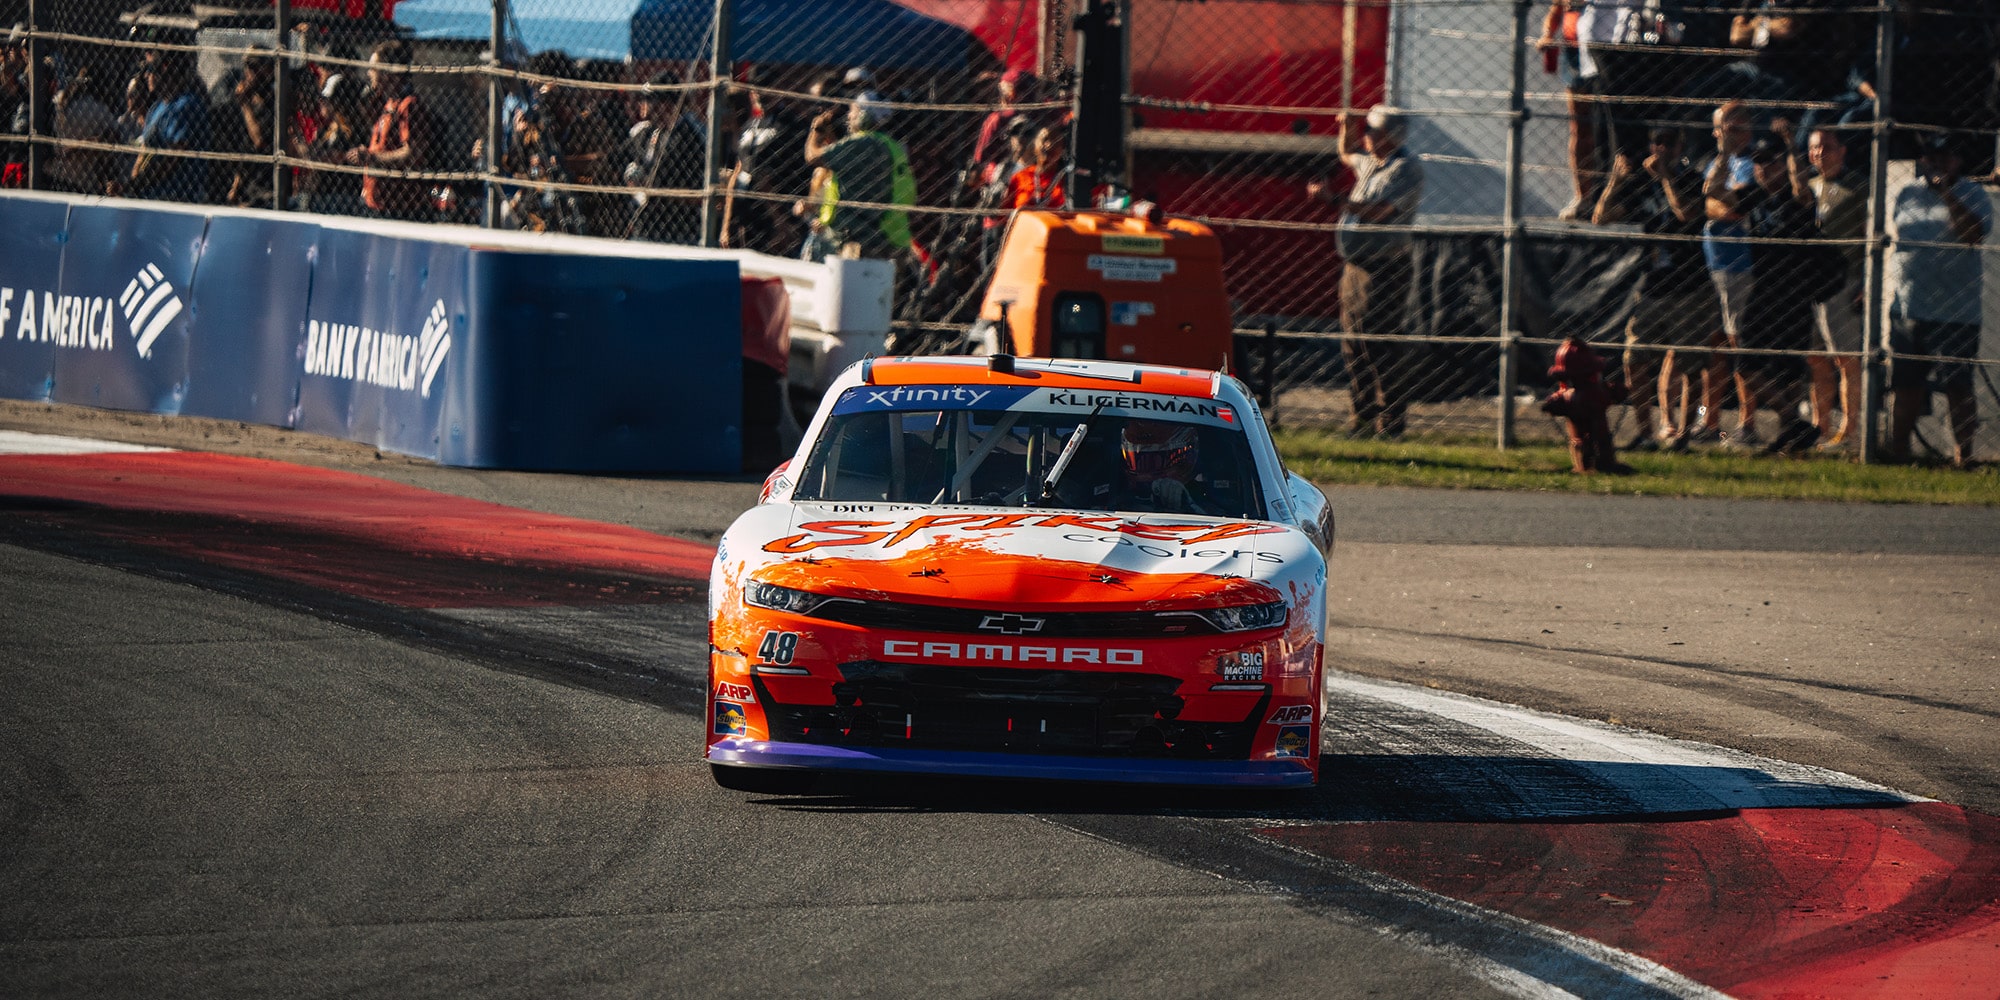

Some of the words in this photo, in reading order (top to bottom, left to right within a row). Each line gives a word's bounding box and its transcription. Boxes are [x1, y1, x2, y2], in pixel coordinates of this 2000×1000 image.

[0, 287, 14, 340] F
[304, 319, 360, 380] BANK
[367, 330, 418, 391] AMRICA
[866, 387, 992, 407] xfinity
[1049, 393, 1218, 418] KLIGERMAN
[761, 513, 1291, 554] SPIKED
[1063, 533, 1284, 564] coolers
[757, 630, 798, 665] 48
[884, 640, 1143, 665] CAMARO
[1241, 652, 1263, 666] BIG
[1224, 666, 1263, 675] MACHINE
[718, 682, 751, 700] ARP
[1271, 705, 1312, 722] ARP
